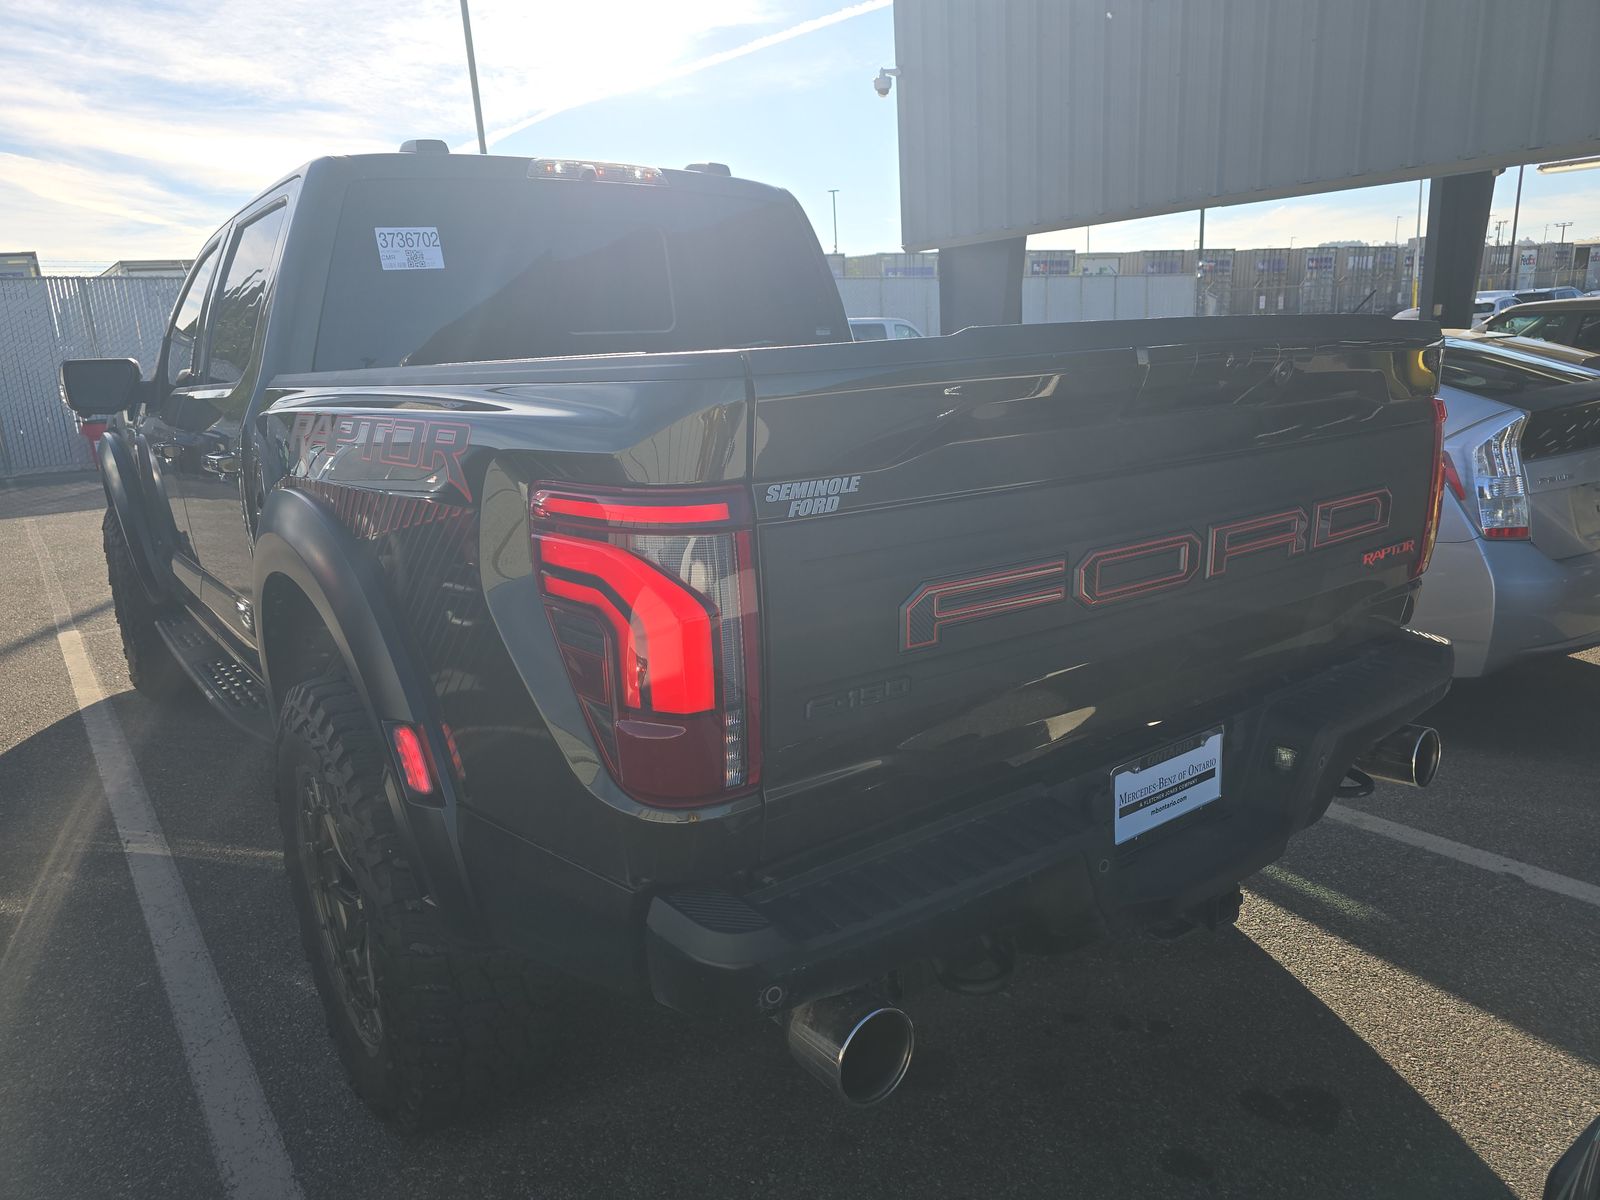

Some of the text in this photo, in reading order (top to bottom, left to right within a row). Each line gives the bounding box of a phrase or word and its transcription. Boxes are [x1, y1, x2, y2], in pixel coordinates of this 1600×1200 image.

[378, 231, 441, 249] 3736702
[288, 411, 473, 504] RAPTOR
[765, 475, 862, 503] SEMINOLE
[788, 495, 840, 518] FORD
[1362, 539, 1416, 566] RAPTOR
[900, 487, 1393, 653] FORD
[1188, 758, 1217, 776] ONTARIO
[1150, 795, 1188, 816] mbontario.com
